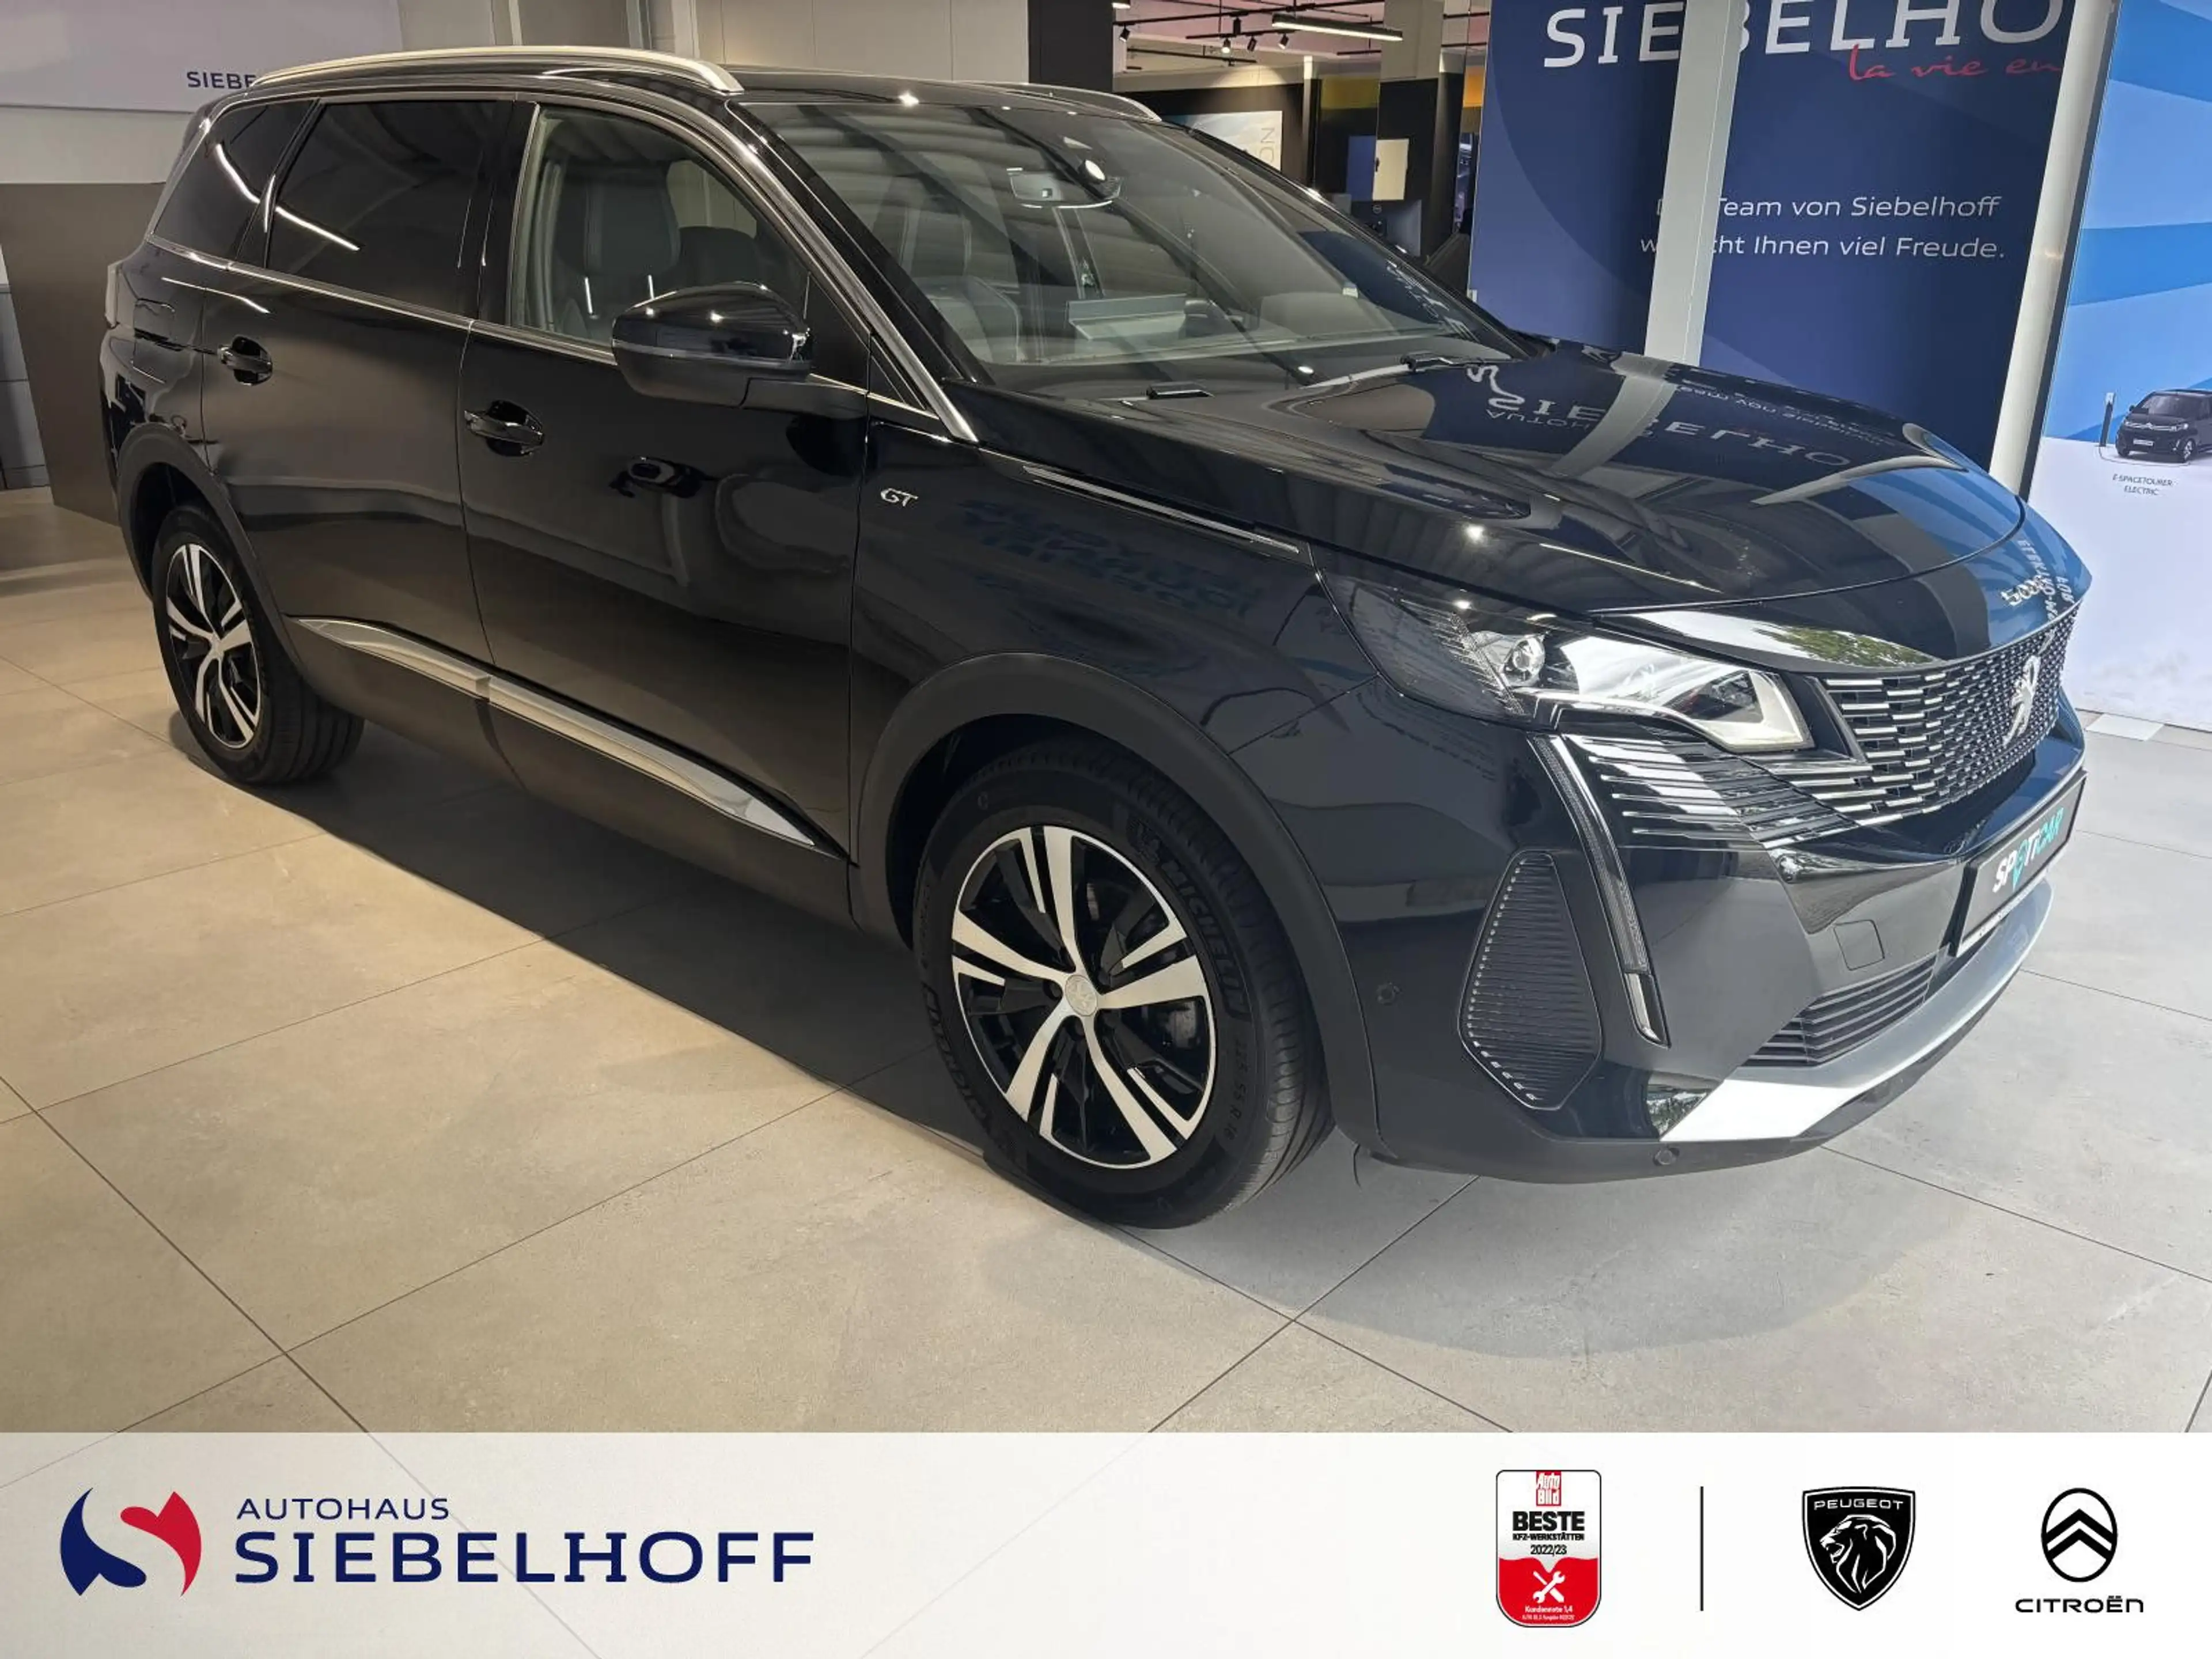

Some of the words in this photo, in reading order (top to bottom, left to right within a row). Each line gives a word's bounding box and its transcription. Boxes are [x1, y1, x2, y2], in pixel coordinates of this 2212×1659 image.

[1543, 0, 2061, 68] SIEELHO
[1911, 55, 1987, 77] vie
[1792, 202, 1840, 215] von
[1851, 196, 2001, 216] Siebelhoff
[1753, 236, 1829, 255] Ihnen
[1840, 237, 1885, 255] viel
[1896, 237, 2006, 257] Freude.
[881, 488, 918, 506] GT
